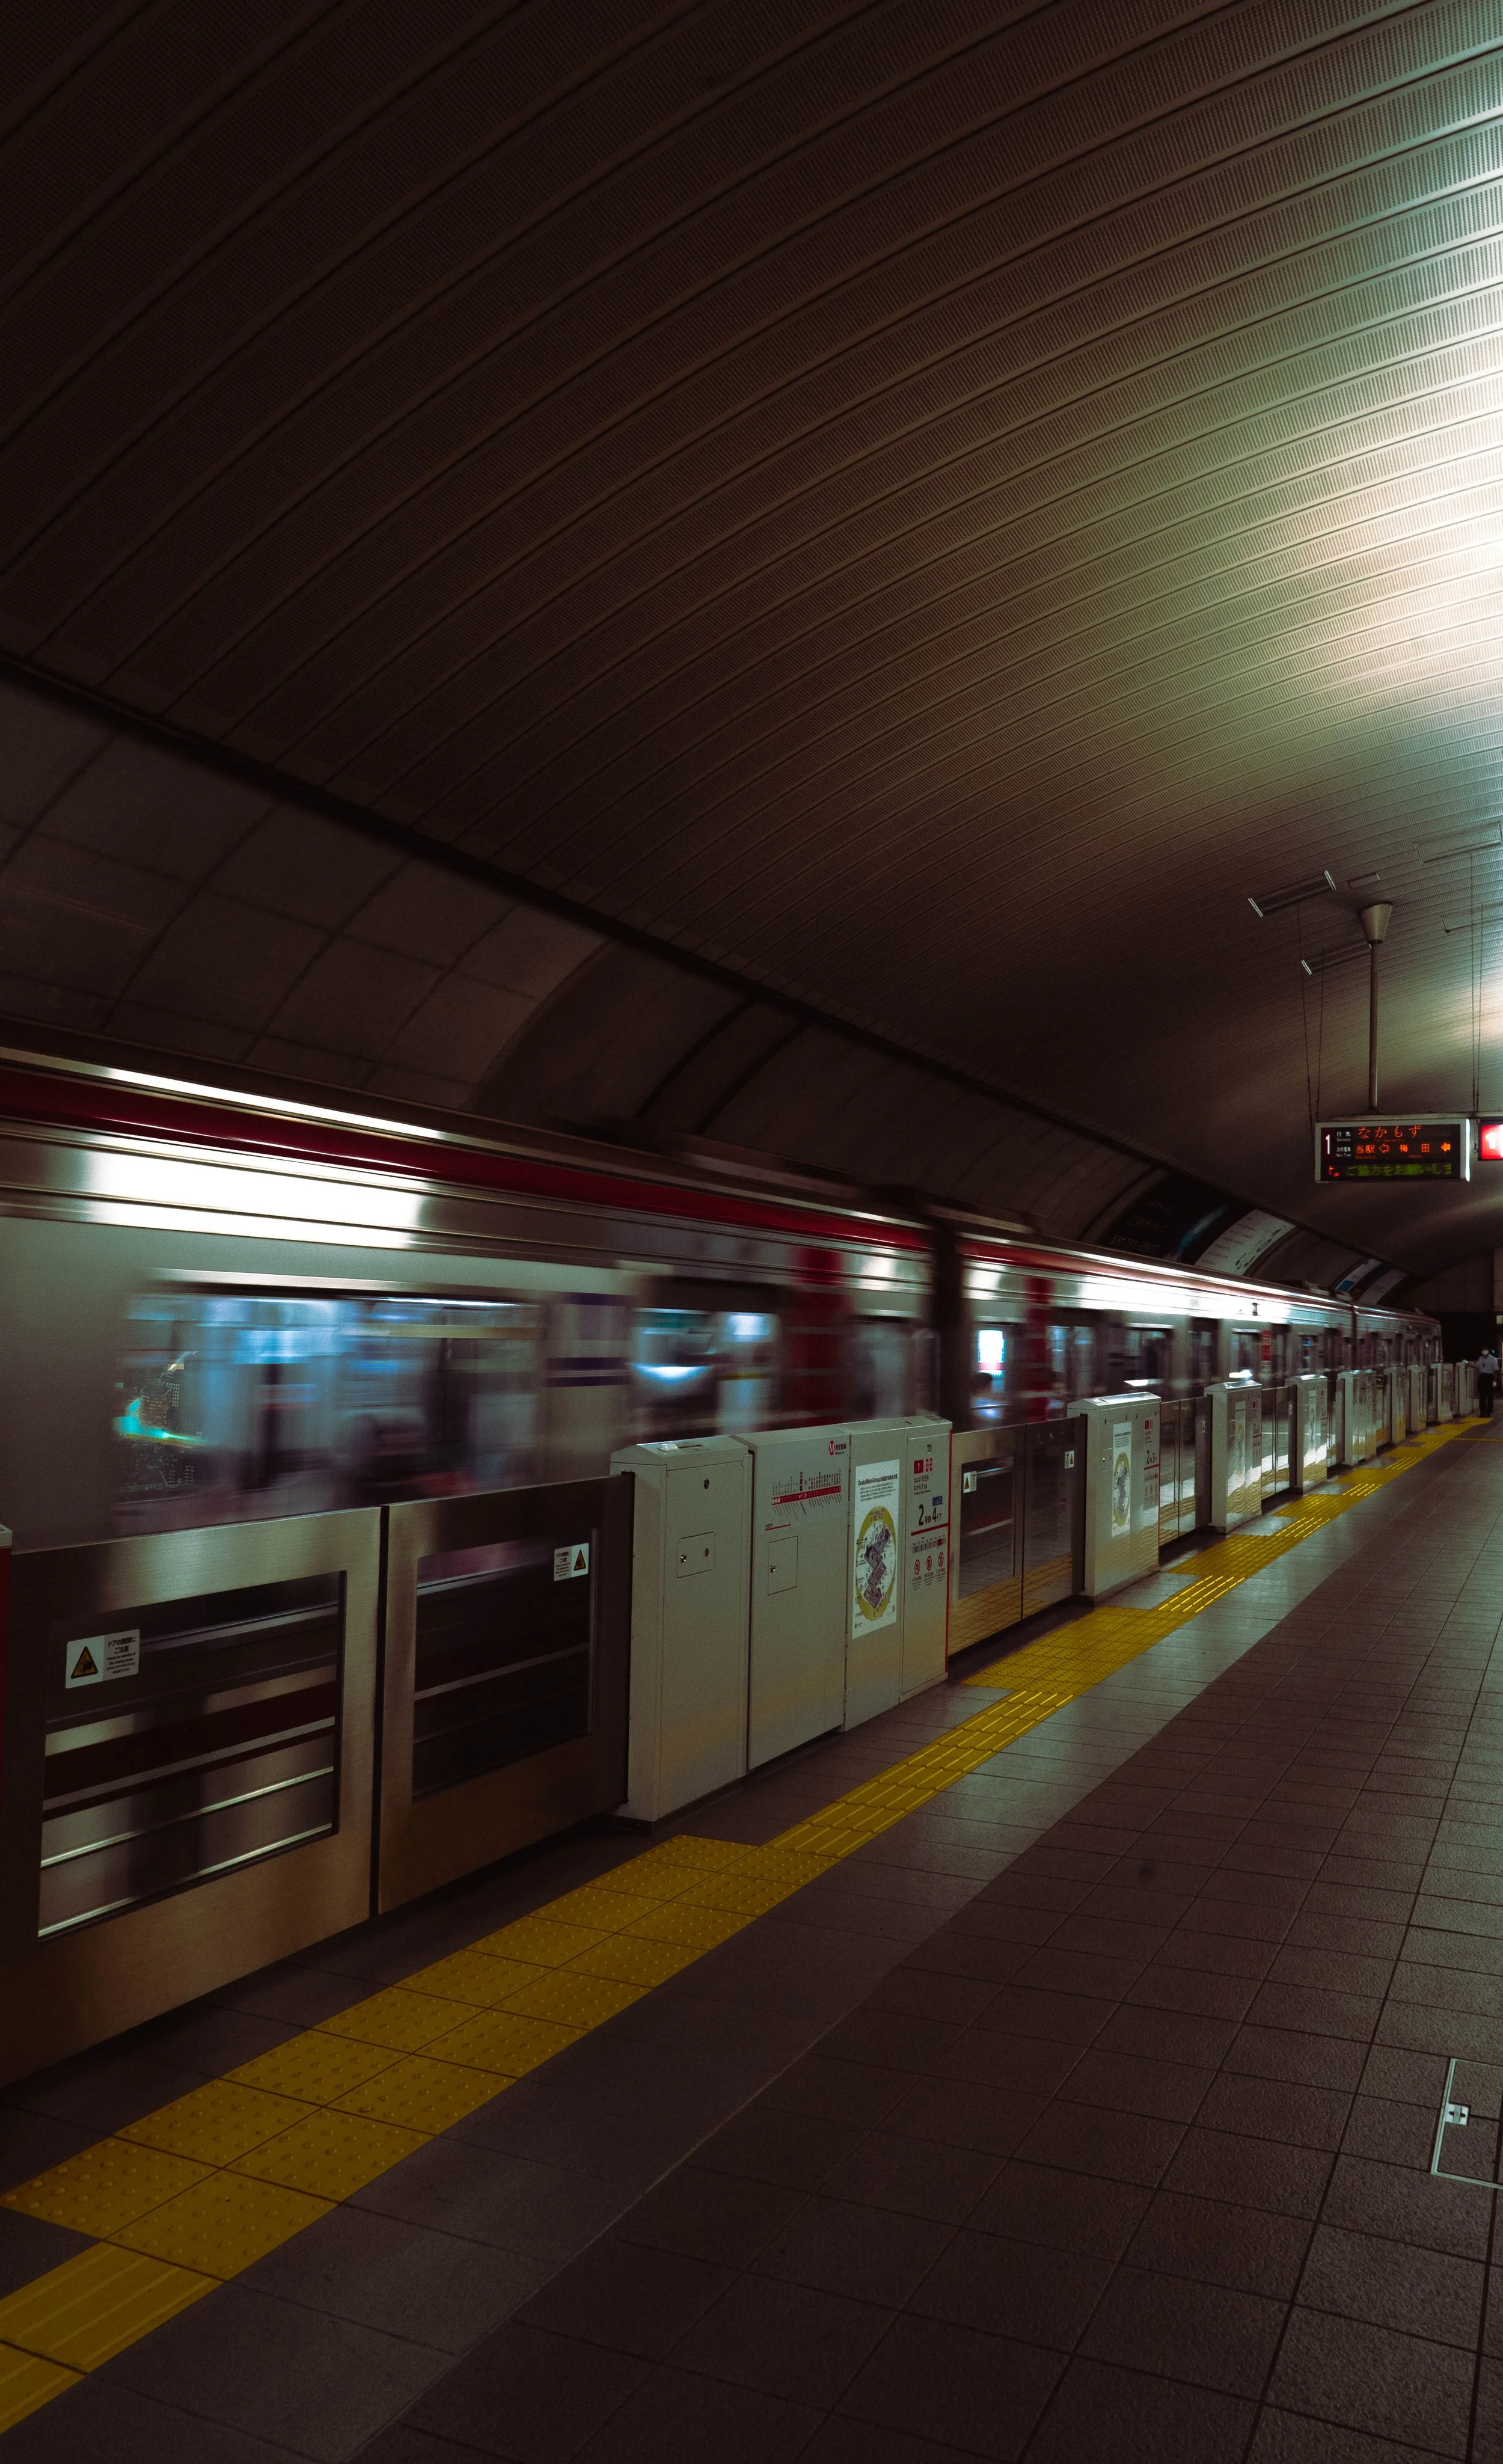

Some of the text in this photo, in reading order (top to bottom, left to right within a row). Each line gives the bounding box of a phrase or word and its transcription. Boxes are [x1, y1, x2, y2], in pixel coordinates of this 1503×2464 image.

[1359, 1125, 1421, 1139] なかもず
[1325, 1134, 1330, 1154] 1
[1485, 1132, 1496, 1149] 1
[1356, 1144, 1430, 1153] 当駅 梅田
